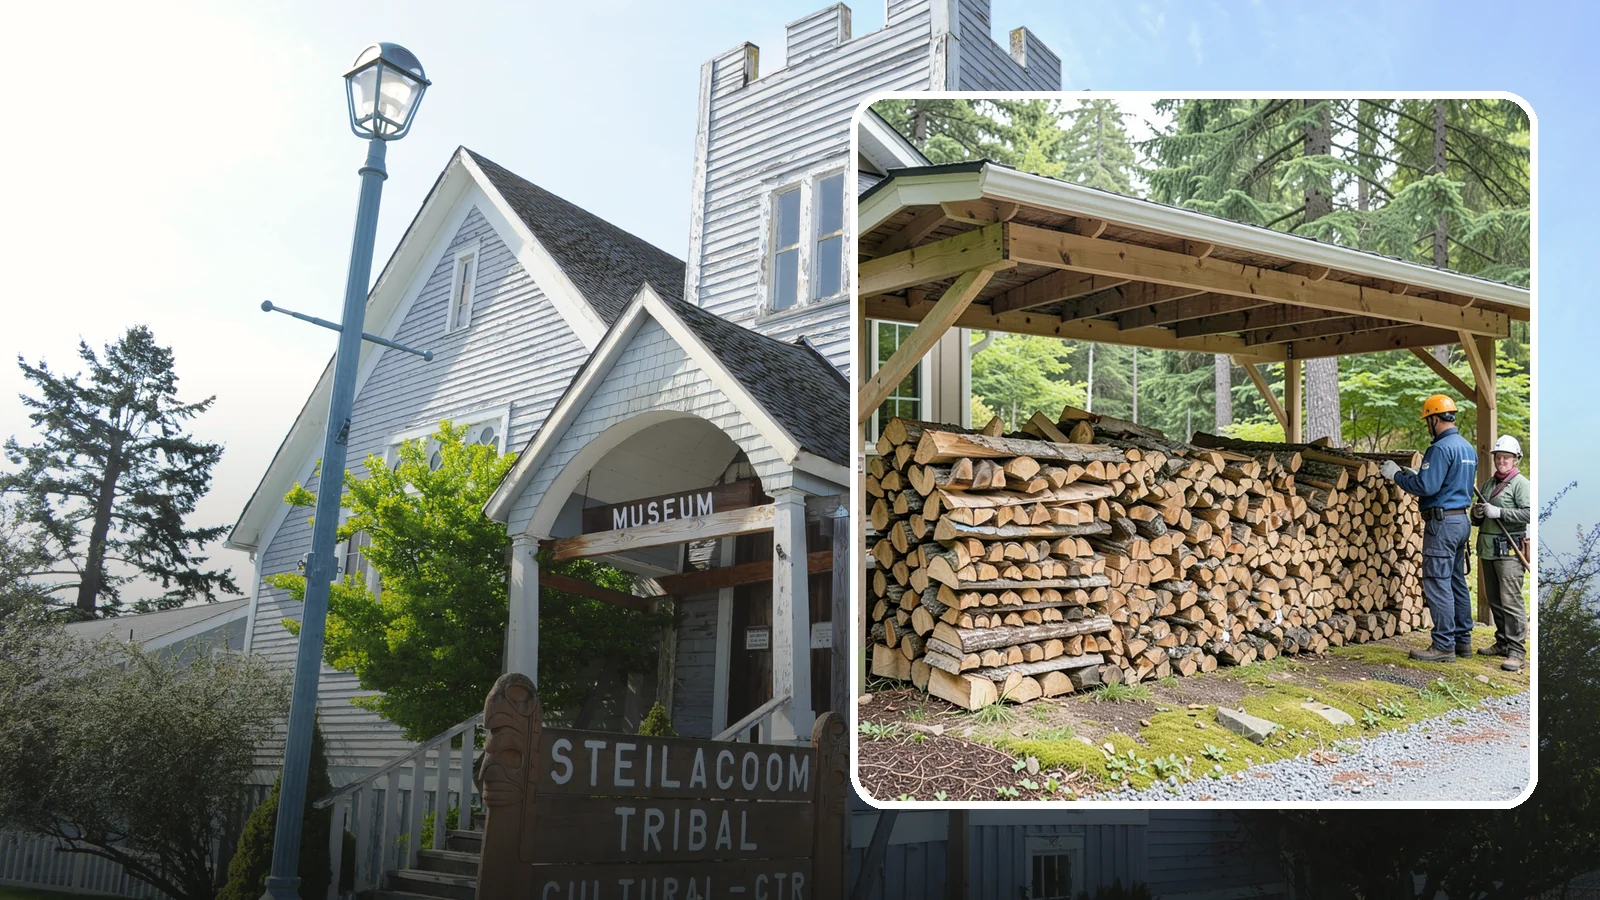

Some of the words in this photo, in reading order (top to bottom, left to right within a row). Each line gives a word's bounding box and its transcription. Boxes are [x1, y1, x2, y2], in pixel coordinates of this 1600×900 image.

[612, 491, 714, 531] MUSEUM
[550, 737, 810, 793] STEILACOOM
[614, 806, 758, 852] TRIBAL
